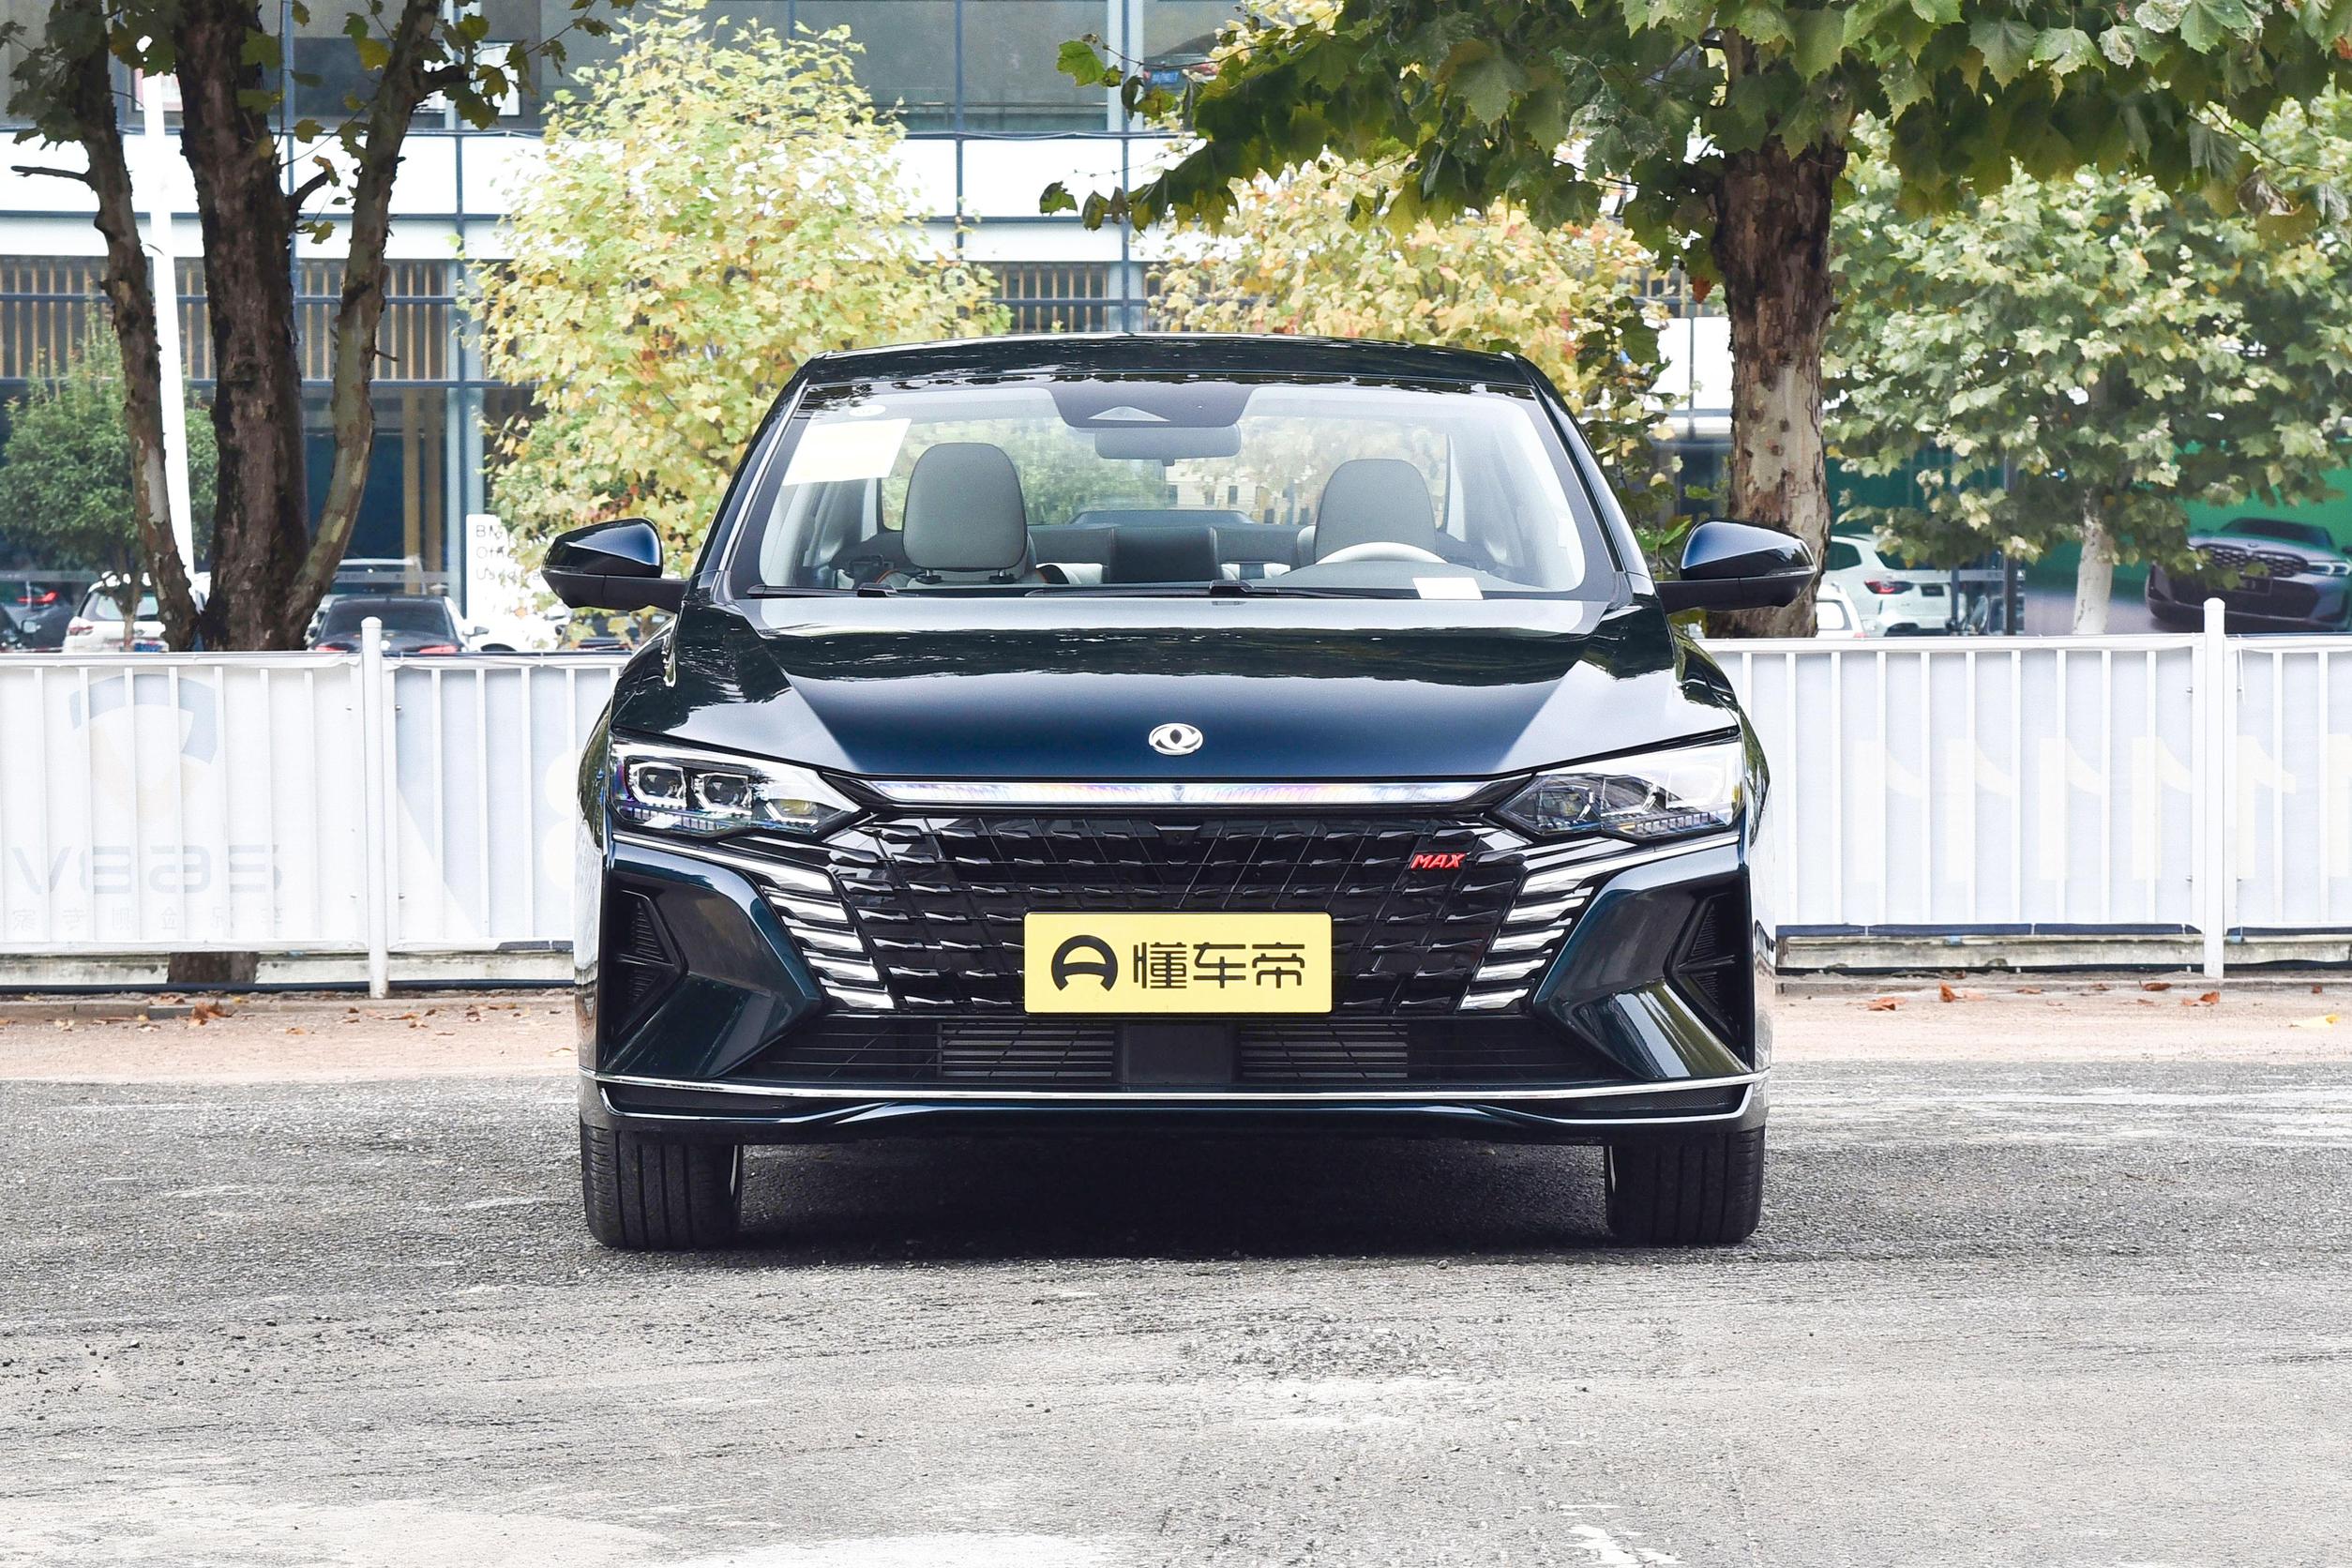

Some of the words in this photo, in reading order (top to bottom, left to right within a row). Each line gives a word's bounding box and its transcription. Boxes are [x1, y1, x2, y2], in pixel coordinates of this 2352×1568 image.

[1410, 852, 1466, 870] MAX
[1133, 942, 1305, 989] 懂车帝
